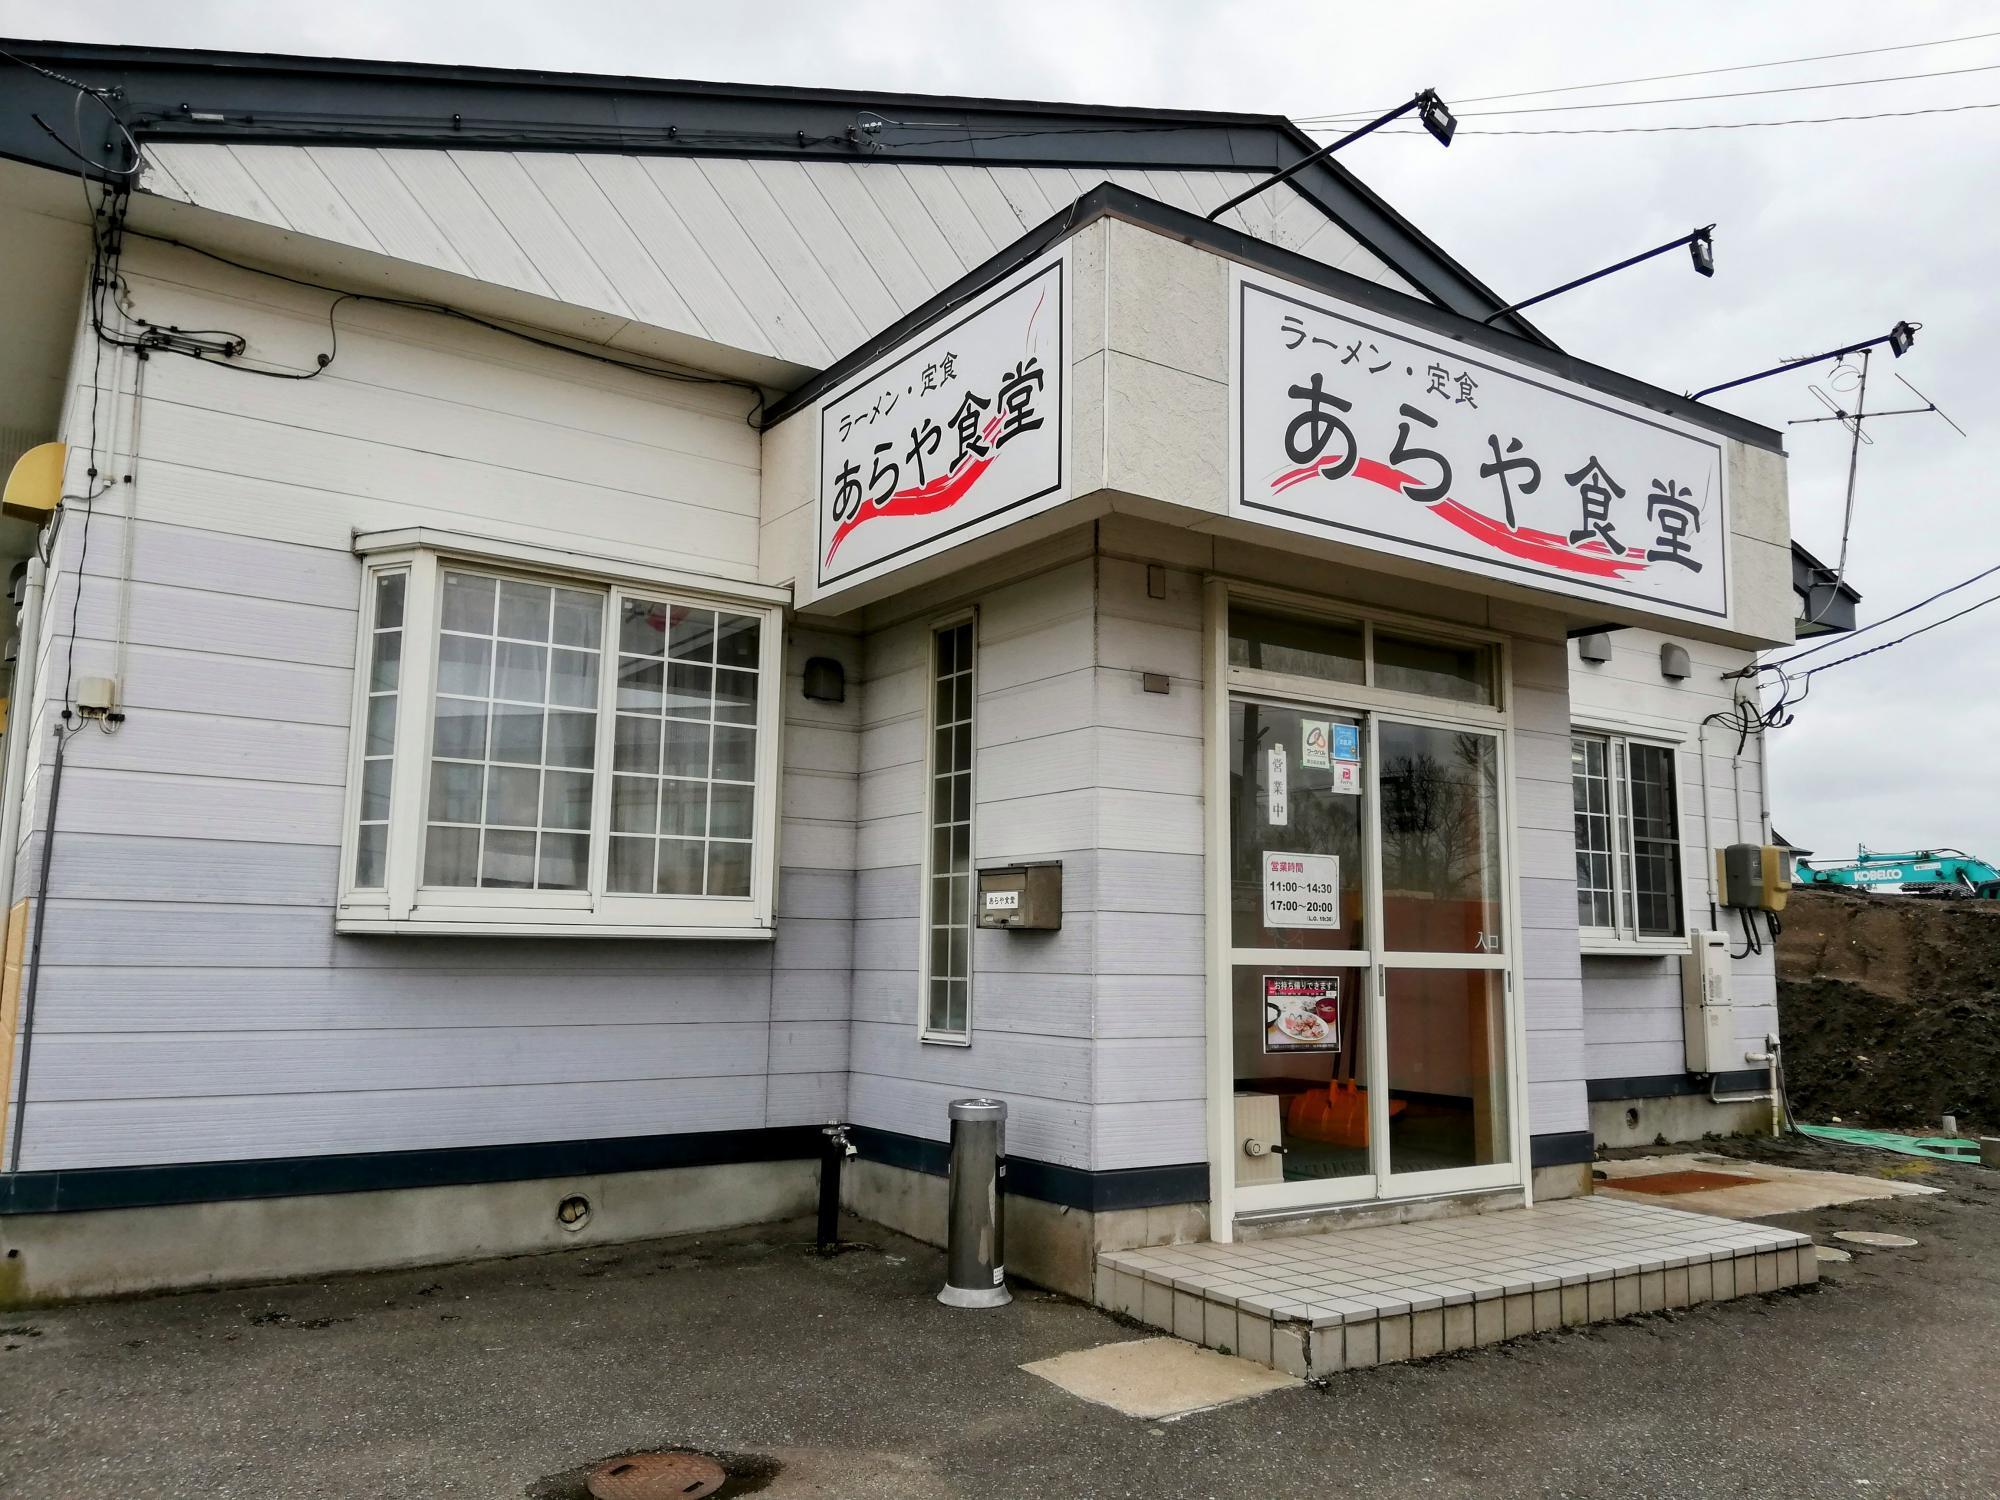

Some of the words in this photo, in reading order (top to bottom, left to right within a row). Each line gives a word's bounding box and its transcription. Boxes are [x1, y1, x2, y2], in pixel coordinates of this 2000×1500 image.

[838, 351, 958, 442] ラーメン・定食
[1281, 315, 1478, 410] ラーメン・定食
[832, 356, 1045, 523] あらや食堂
[1284, 373, 1703, 574] あらや食堂
[1272, 758, 1284, 818] 営業中
[1270, 860, 1304, 874] 営業時間
[1854, 869, 1902, 881] KOBELCO
[1474, 931, 1499, 950] 入口
